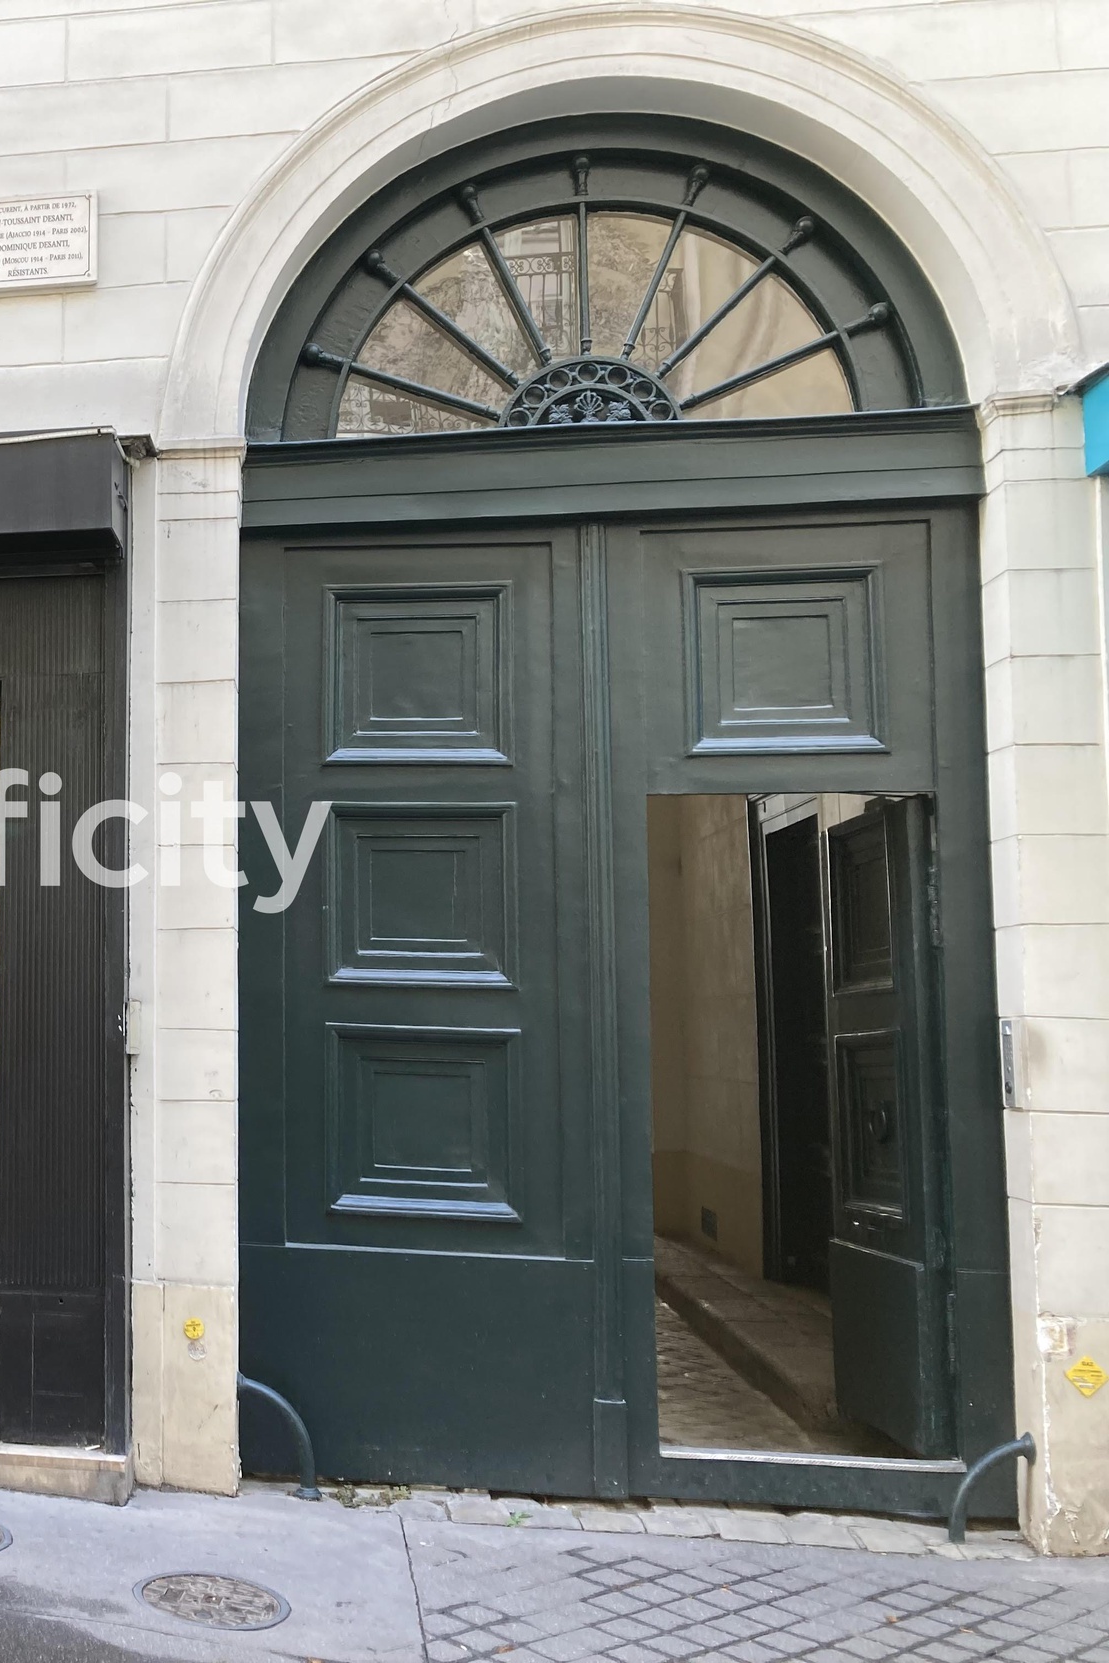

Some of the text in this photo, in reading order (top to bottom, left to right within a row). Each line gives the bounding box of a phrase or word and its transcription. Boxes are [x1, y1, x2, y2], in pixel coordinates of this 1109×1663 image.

[30, 203, 50, 211] PARTIR
[42, 214, 74, 224] DESANTI,
[39, 240, 70, 249] DESANTI,
